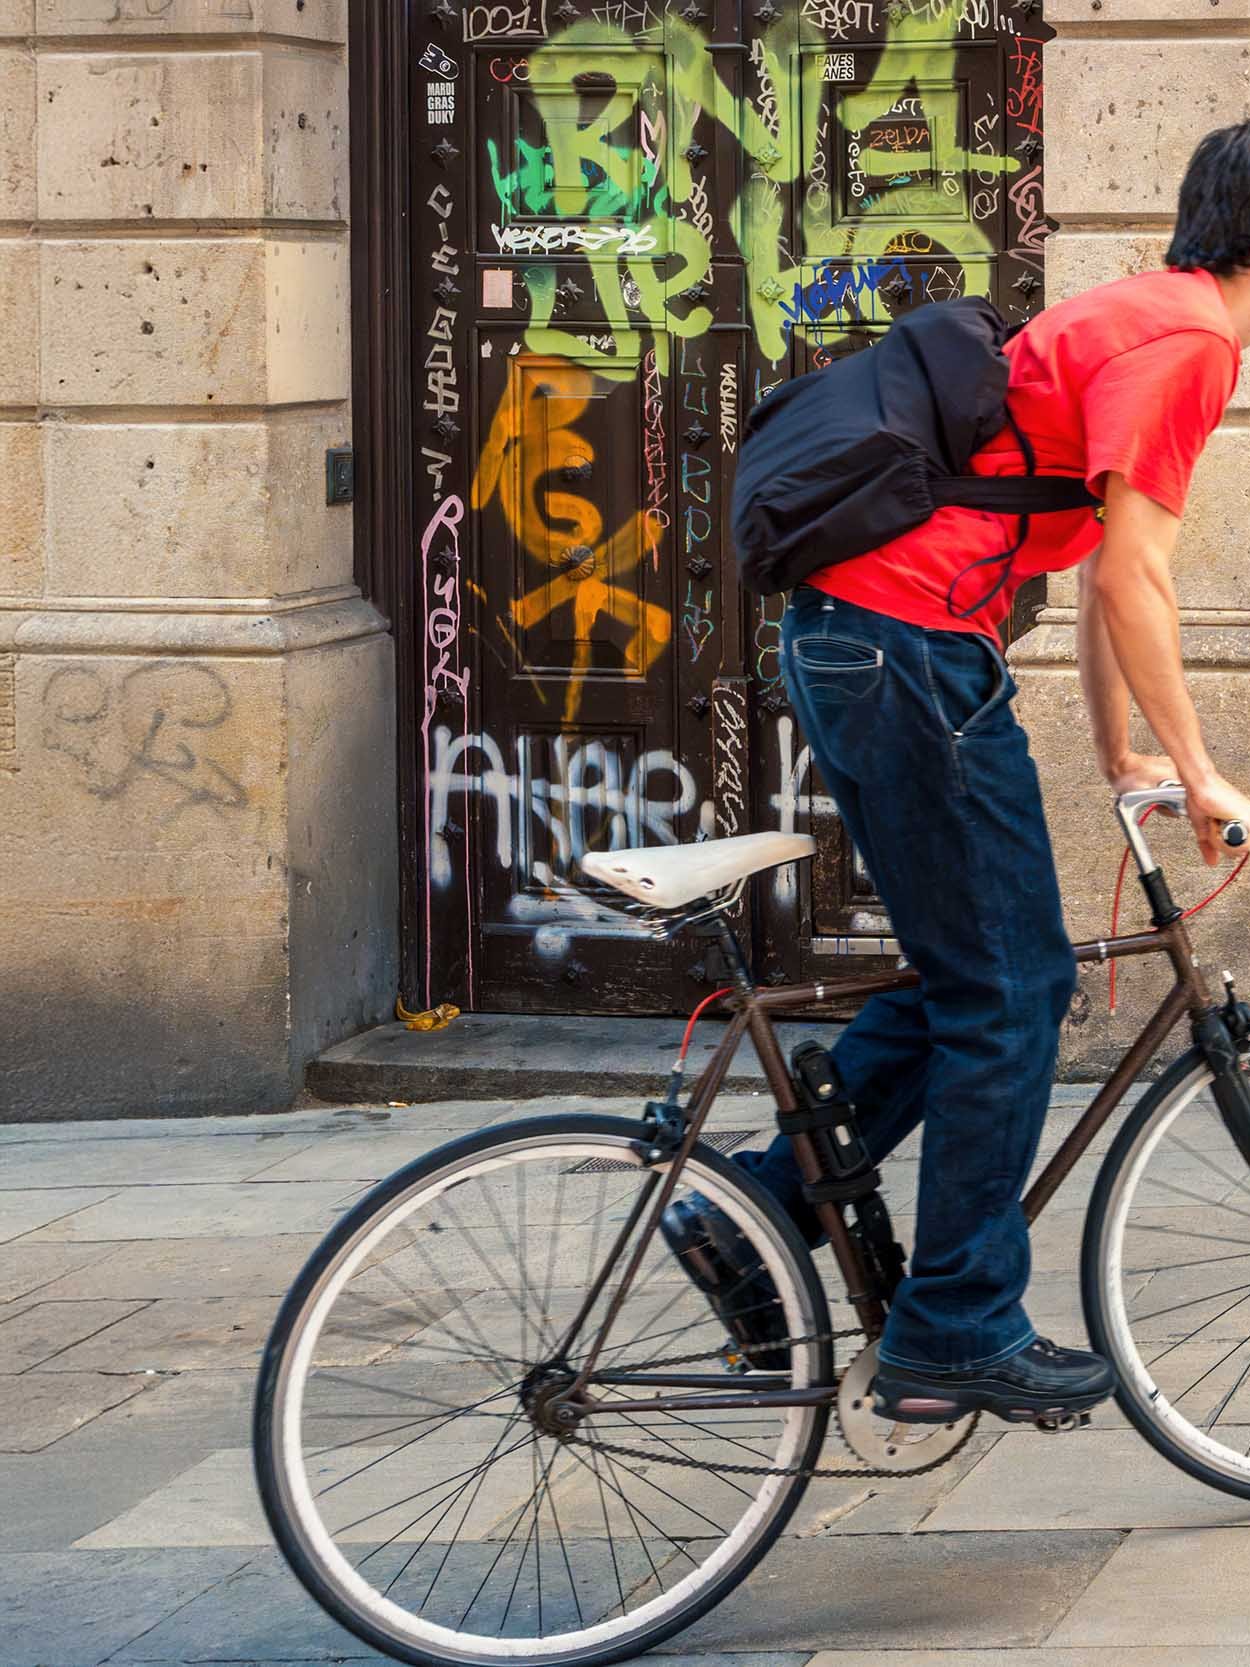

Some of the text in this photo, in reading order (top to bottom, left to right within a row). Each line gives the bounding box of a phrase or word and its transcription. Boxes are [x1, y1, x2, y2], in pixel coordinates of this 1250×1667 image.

[427, 82, 455, 96] MARDI
[427, 96, 455, 110] GRAS
[427, 110, 455, 124] DUKY
